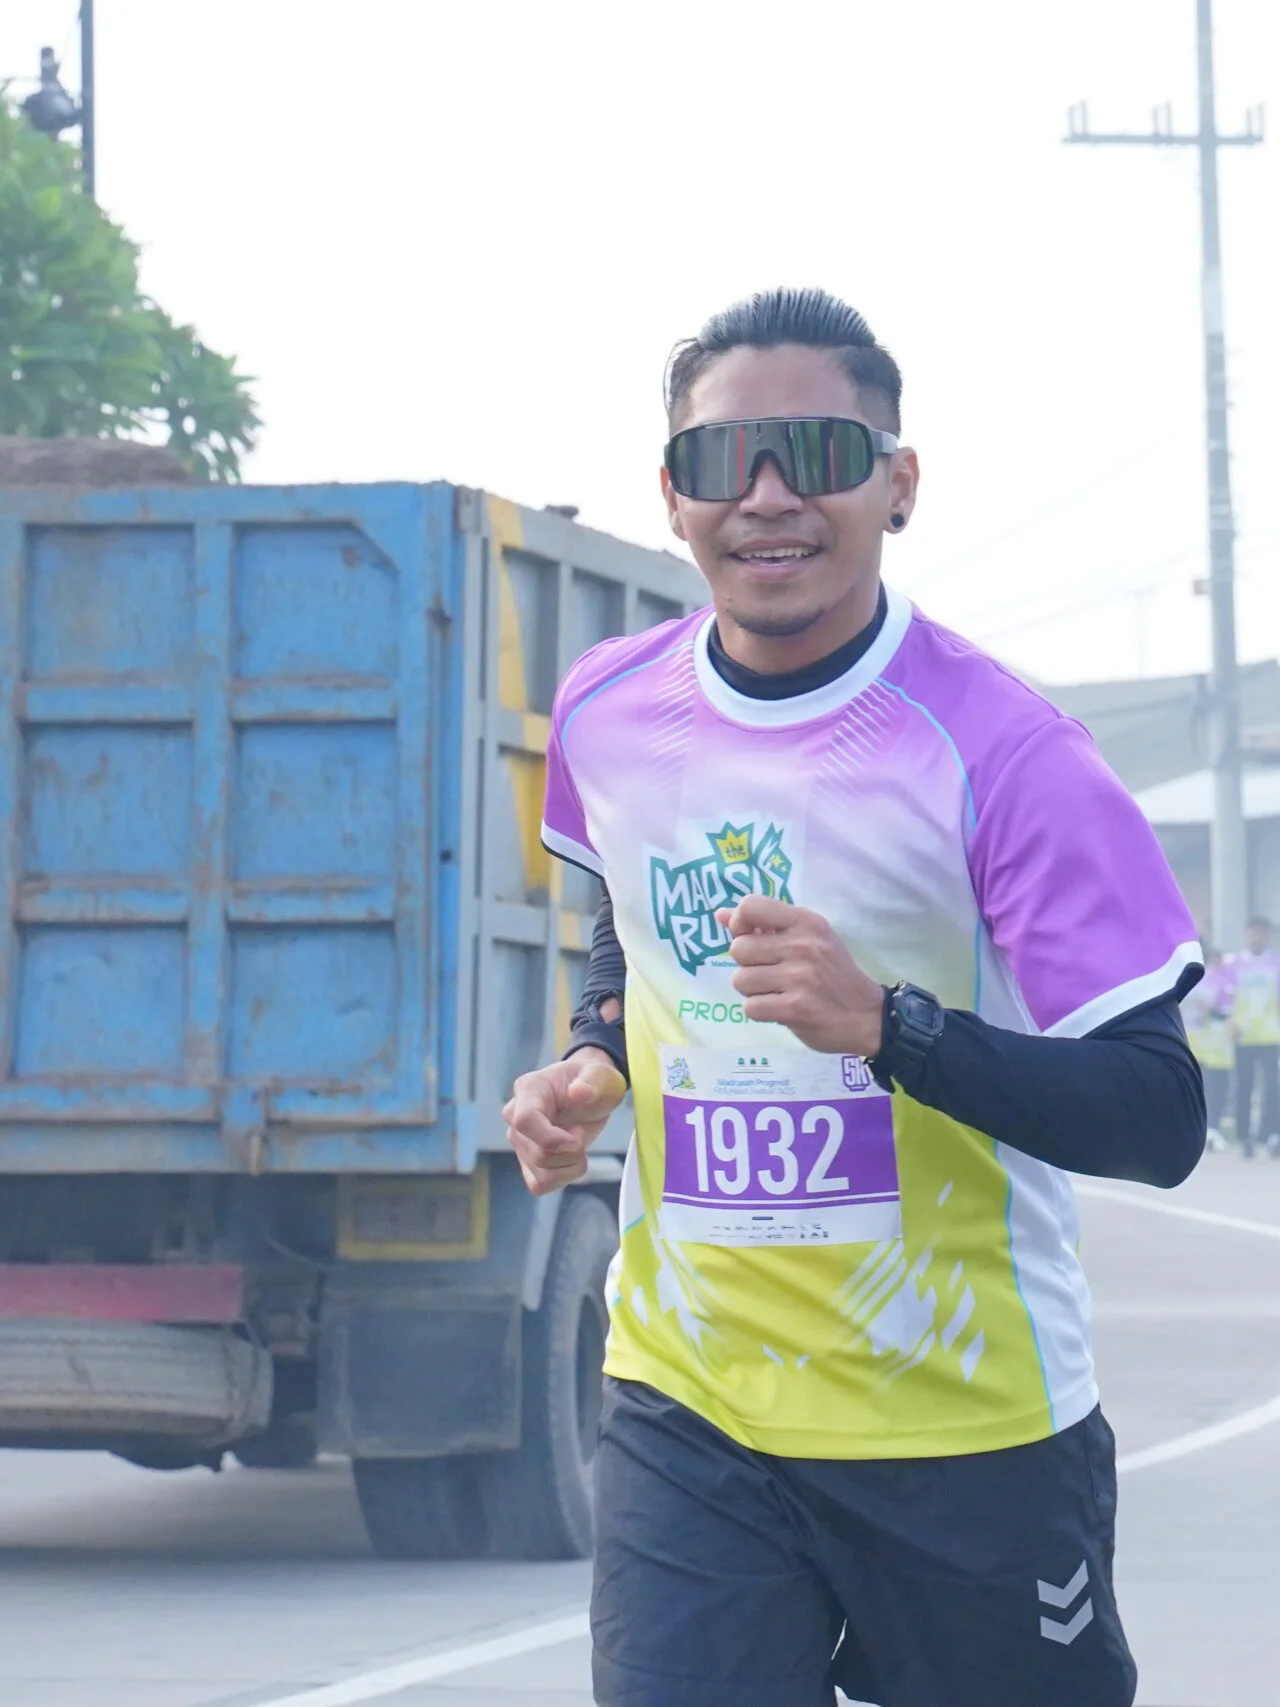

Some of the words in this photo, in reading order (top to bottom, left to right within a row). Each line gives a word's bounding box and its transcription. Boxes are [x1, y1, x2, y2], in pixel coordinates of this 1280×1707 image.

[725, 842, 747, 858] the
[670, 913, 733, 962] RU
[678, 1000, 748, 1023] PROG
[842, 1055, 870, 1087] 5K
[685, 1105, 850, 1195] 1932
